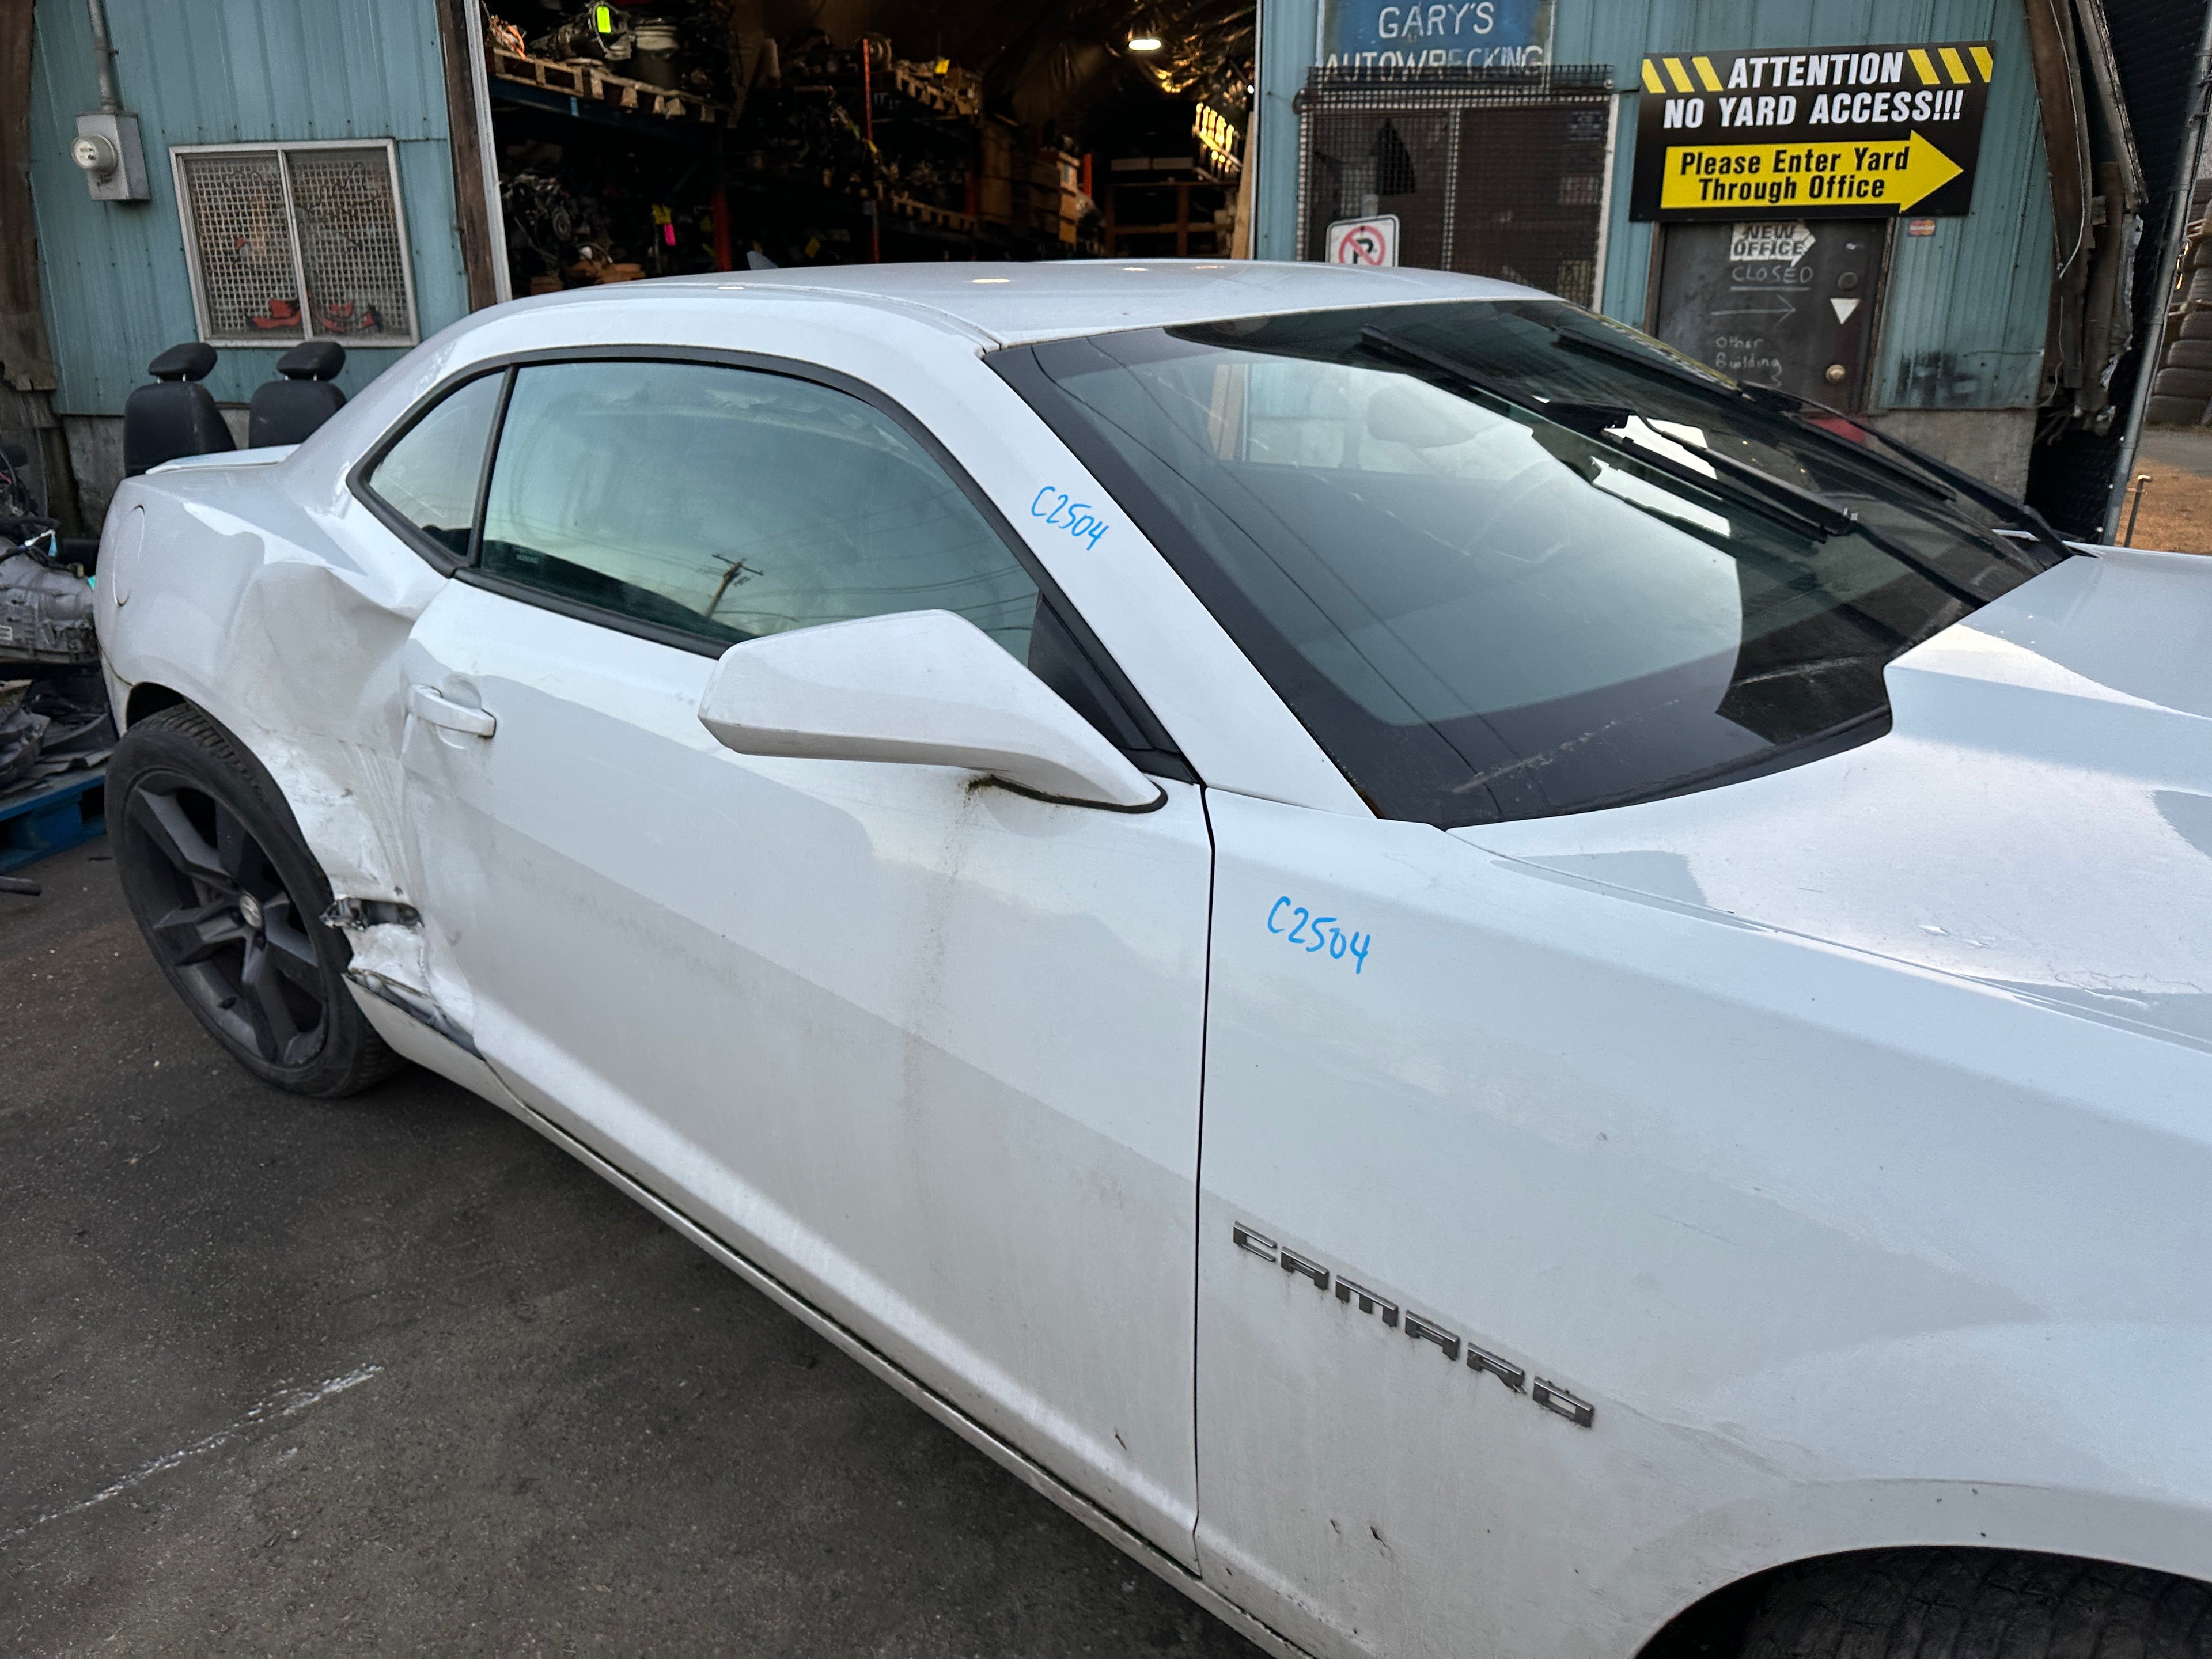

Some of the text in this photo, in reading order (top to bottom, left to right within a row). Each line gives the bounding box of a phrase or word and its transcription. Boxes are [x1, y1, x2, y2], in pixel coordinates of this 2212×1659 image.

[1378, 2, 1494, 38] GARY'S
[1728, 52, 1903, 89] ATTENTION
[1664, 90, 1963, 128] NO YARD ACCESS!!!
[1681, 146, 1910, 175] Please Enter Yard
[1699, 175, 1884, 203] Through Office
[1734, 240, 1805, 257] OFFICE
[1745, 225, 1795, 240] NEW
[1732, 266, 1813, 283] CLOSED
[1031, 486, 1109, 551] C2504
[1268, 896, 1370, 974] C2504
[1233, 1221, 1594, 1428] CAMARO
